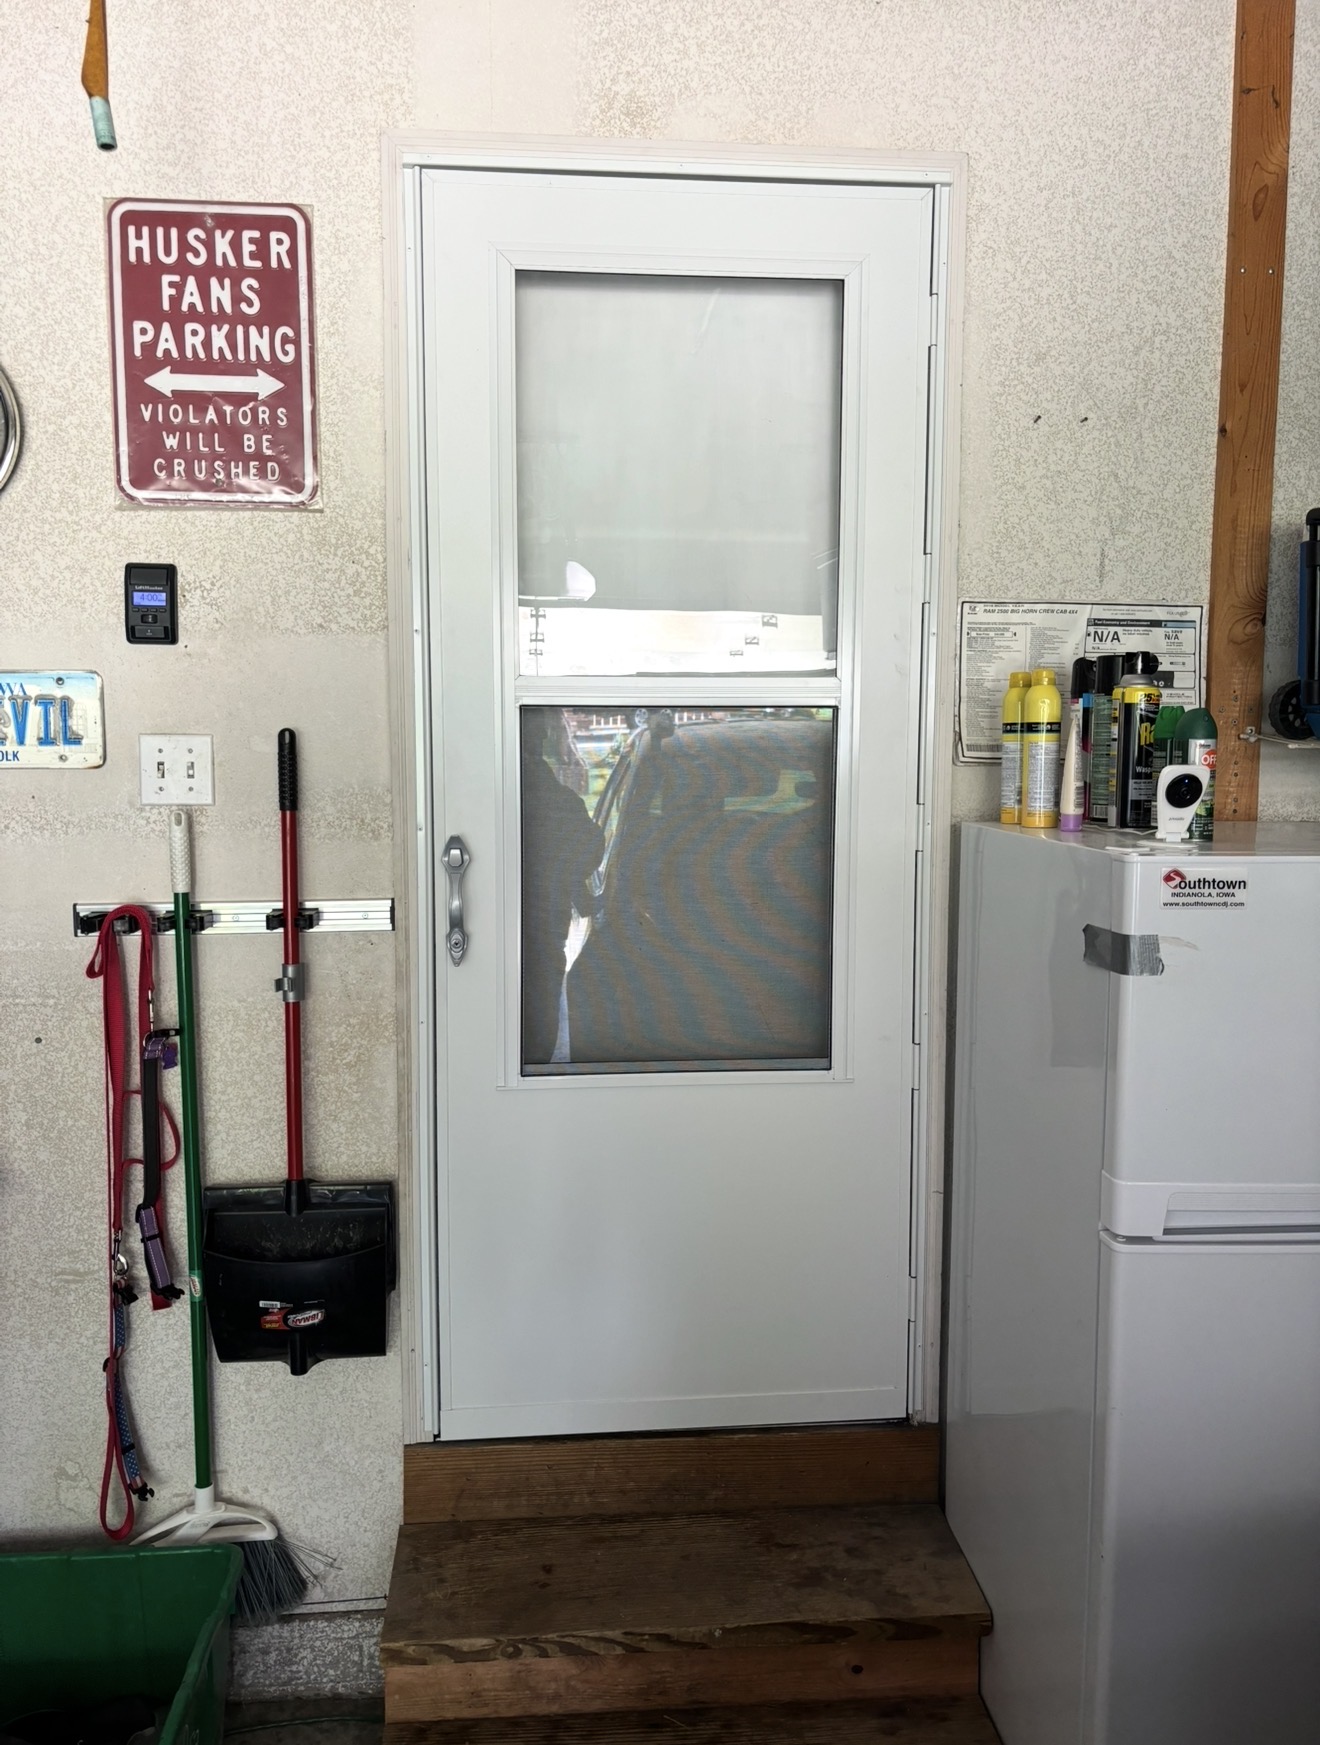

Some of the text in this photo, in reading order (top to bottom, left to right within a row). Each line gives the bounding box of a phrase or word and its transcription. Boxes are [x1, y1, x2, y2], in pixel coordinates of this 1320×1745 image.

[128, 225, 292, 269] HUSKER
[161, 275, 261, 315] FANS
[132, 320, 296, 363] PARKING
[140, 403, 288, 426] VIOLATORS
[162, 431, 273, 455] WILL BE
[153, 458, 280, 482] CRUSHED
[1093, 630, 1121, 643] N/A
[1164, 633, 1180, 641] N/A
[0, 696, 83, 747] VIL
[1162, 901, 1245, 909] www.southtowncdj.com
